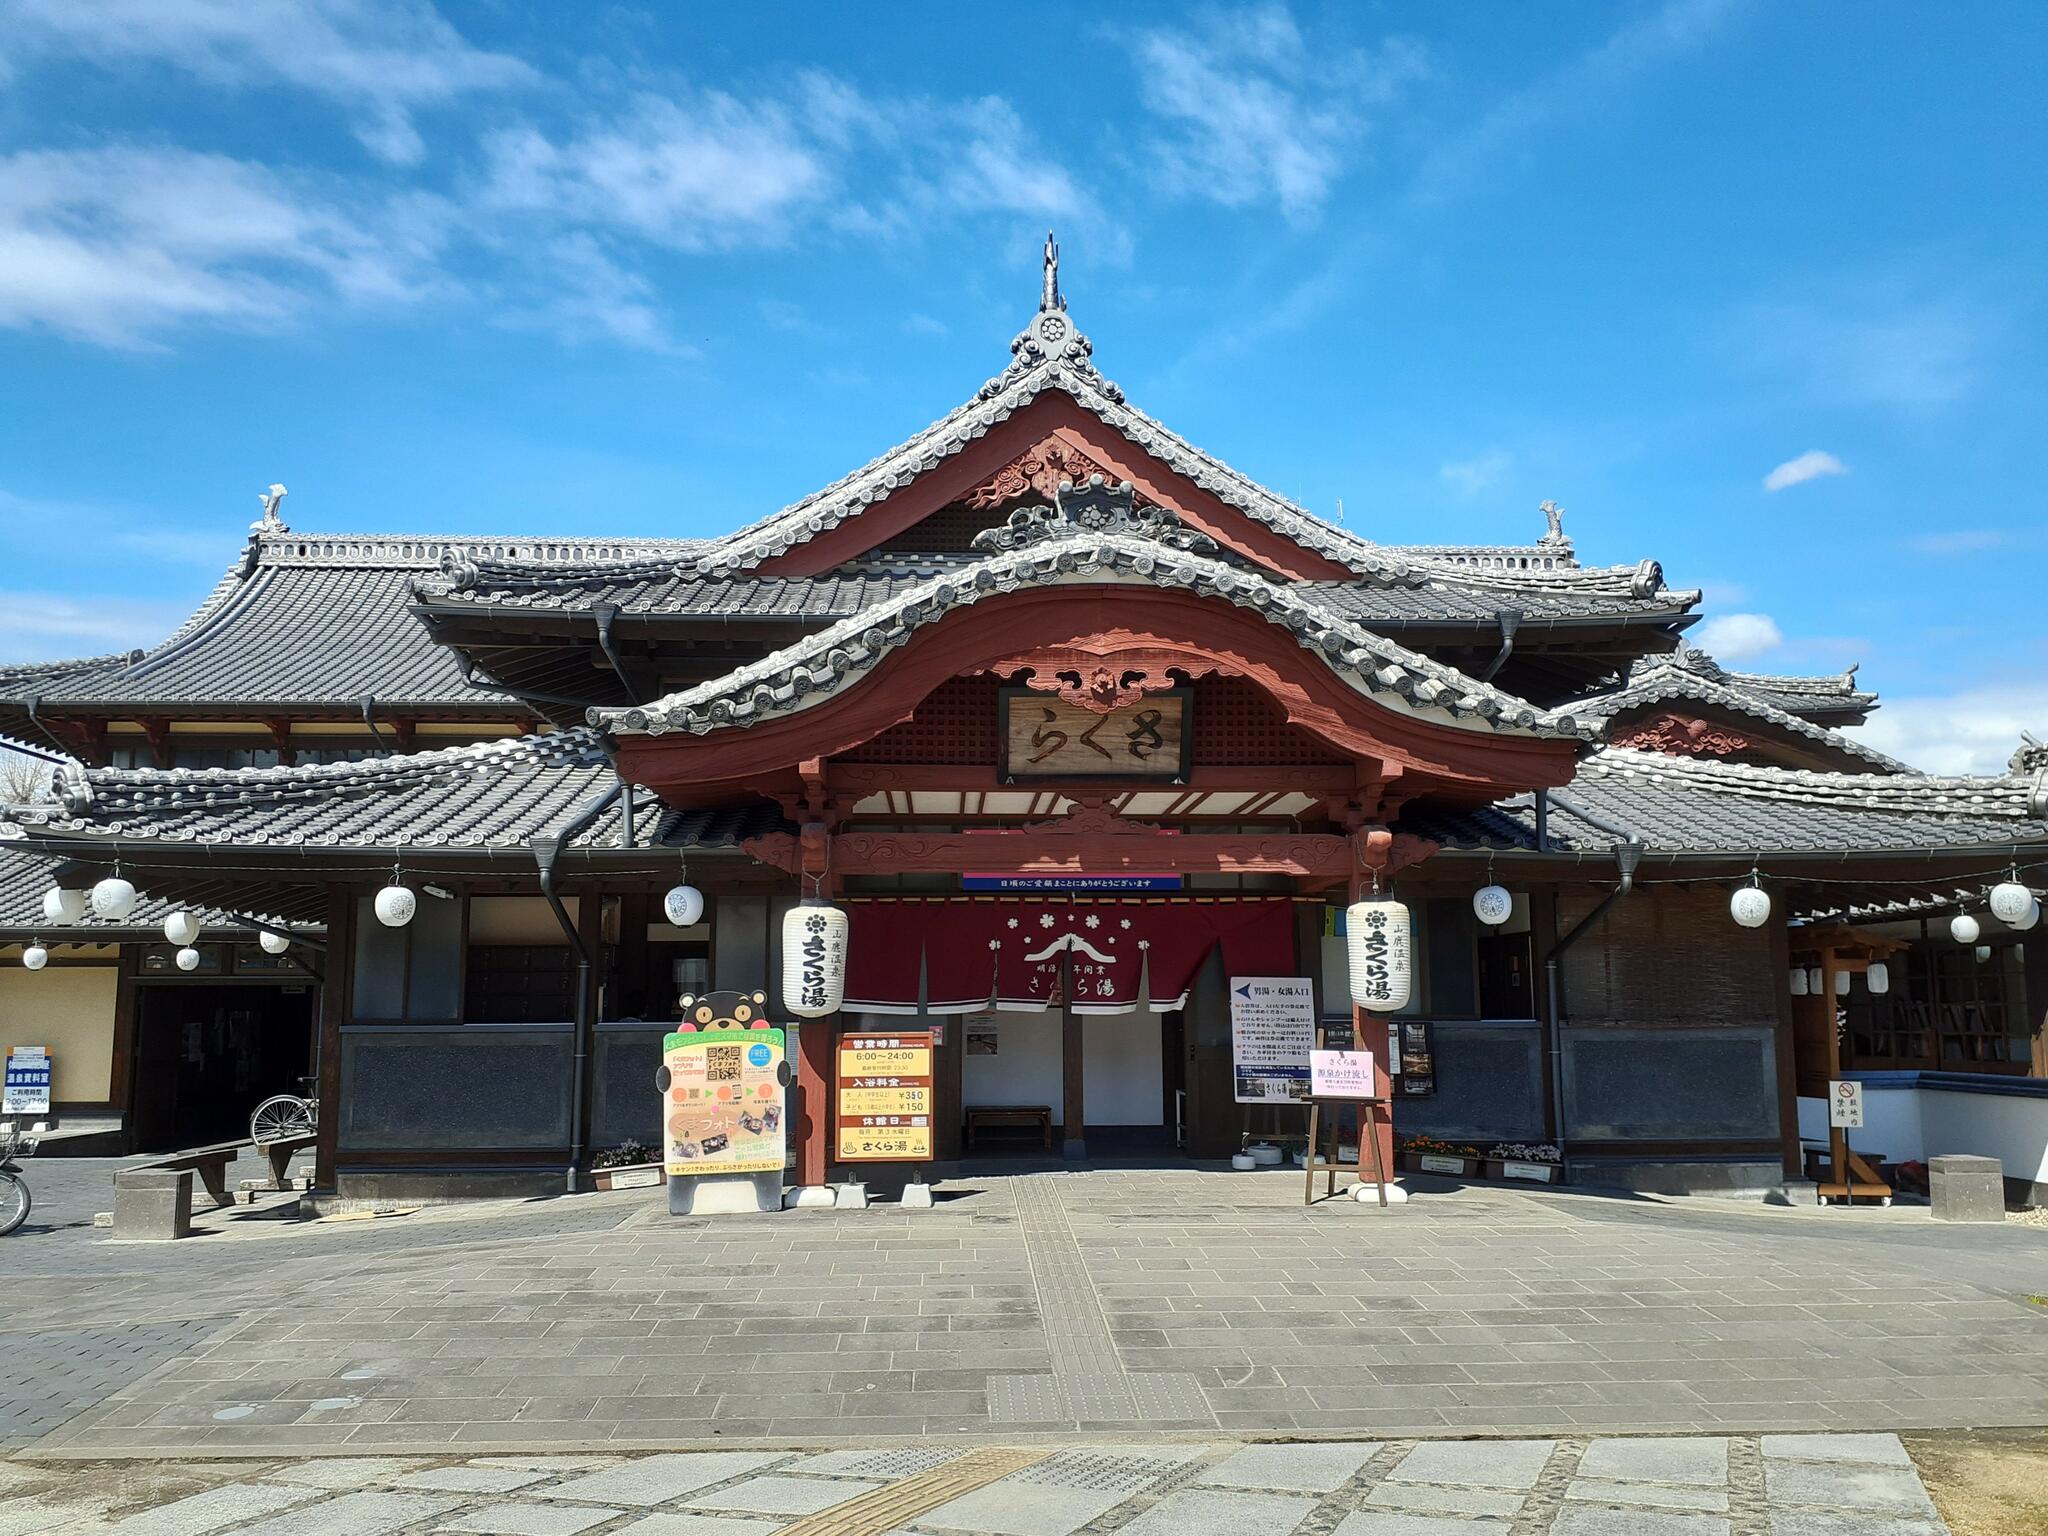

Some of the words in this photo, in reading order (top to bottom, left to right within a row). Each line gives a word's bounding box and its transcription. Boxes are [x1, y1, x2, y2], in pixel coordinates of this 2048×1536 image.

[831, 930, 842, 977] 山鹿温泉
[1393, 924, 1405, 972] 山鹿温泉
[1036, 964, 1107, 975] 明治年開業
[1364, 931, 1392, 1000] さくら湯
[802, 935, 828, 1008] さくら湯
[1254, 986, 1309, 996] 男湯・女湯入口
[853, 1039, 900, 1049] 営業時間
[751, 1048, 769, 1058] FREE
[7, 1073, 49, 1084] 温泉資料室
[1317, 1068, 1369, 1079] 源泉かけ流し
[852, 1078, 900, 1088] 入浴料金
[862, 1116, 900, 1126] 休館日
[862, 1141, 908, 1152] さくら湯
